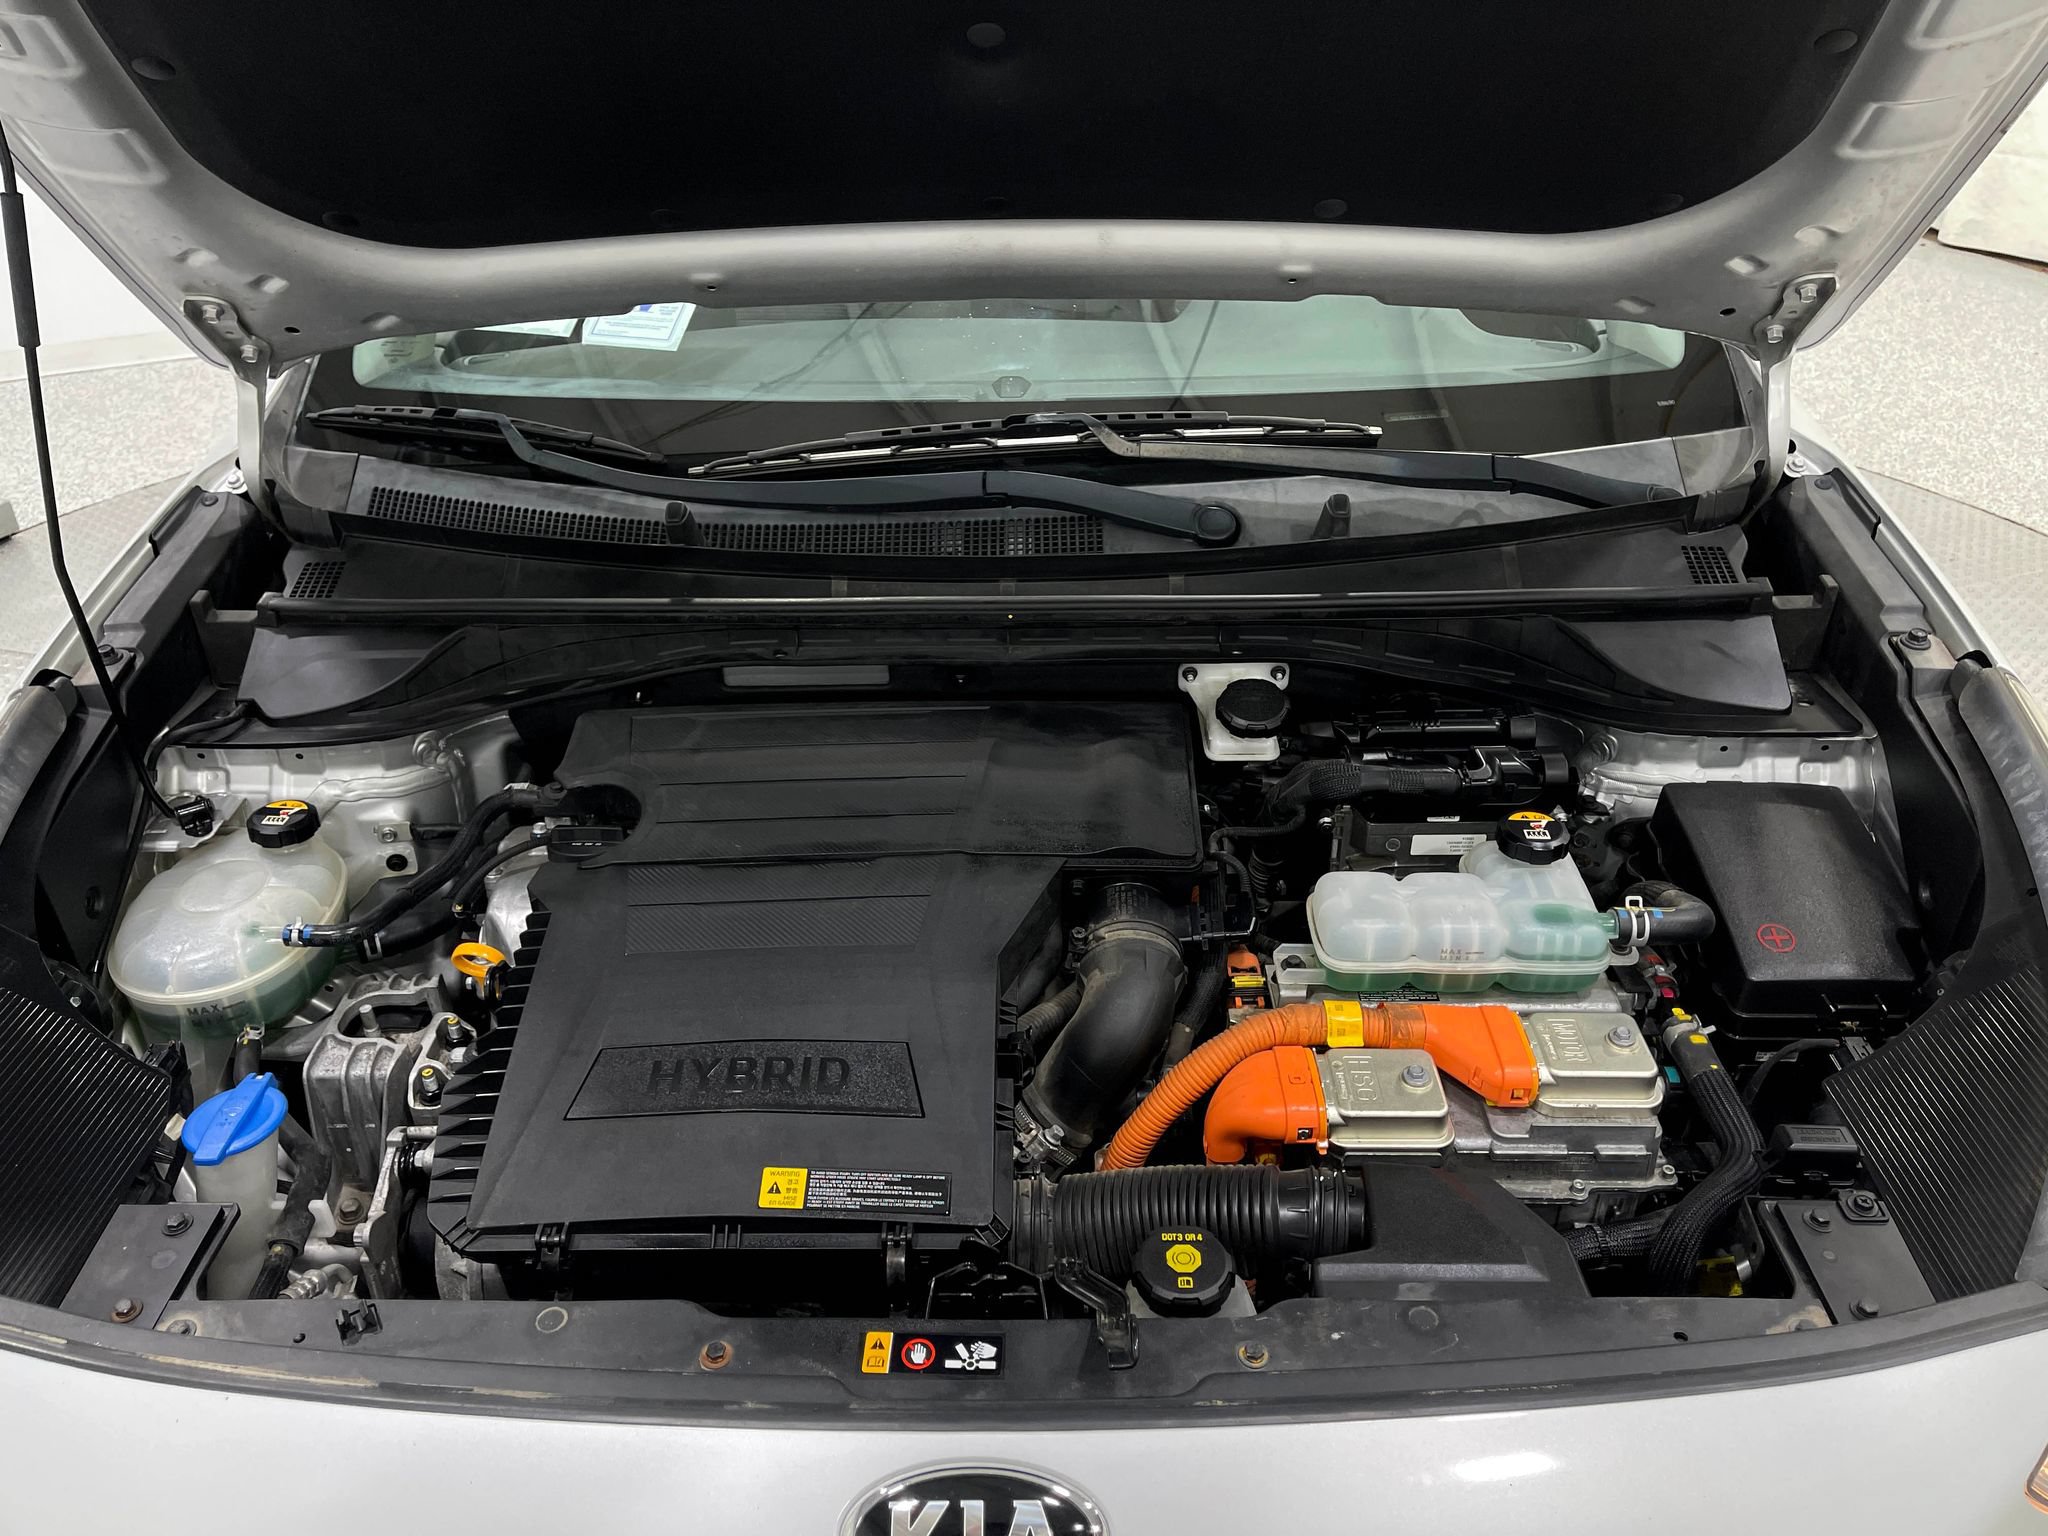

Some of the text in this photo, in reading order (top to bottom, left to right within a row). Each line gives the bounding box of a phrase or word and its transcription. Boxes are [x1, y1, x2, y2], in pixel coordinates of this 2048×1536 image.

[186, 1003, 221, 1016] MAX
[647, 1056, 850, 1096] HYBRID
[1185, 1233, 1196, 1241] OR
[1197, 1233, 1203, 1241] 4
[889, 1500, 1053, 1536] KIA
